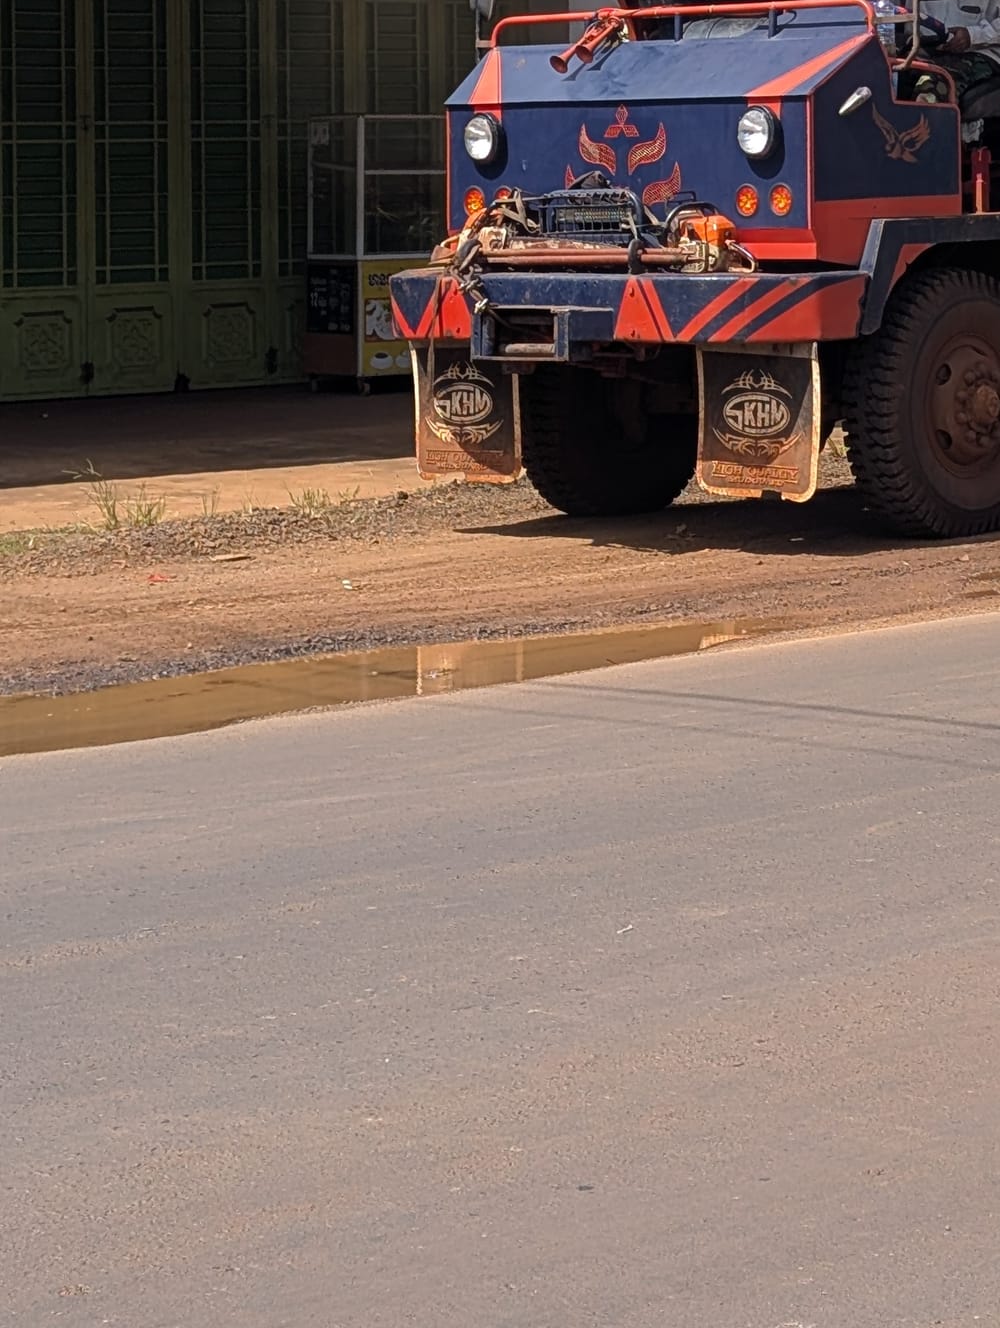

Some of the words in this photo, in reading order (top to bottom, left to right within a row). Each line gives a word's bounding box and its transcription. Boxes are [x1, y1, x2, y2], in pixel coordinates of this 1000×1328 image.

[434, 384, 490, 421] SKHM
[726, 394, 788, 433] SKHM
[712, 463, 743, 475] HIGH
